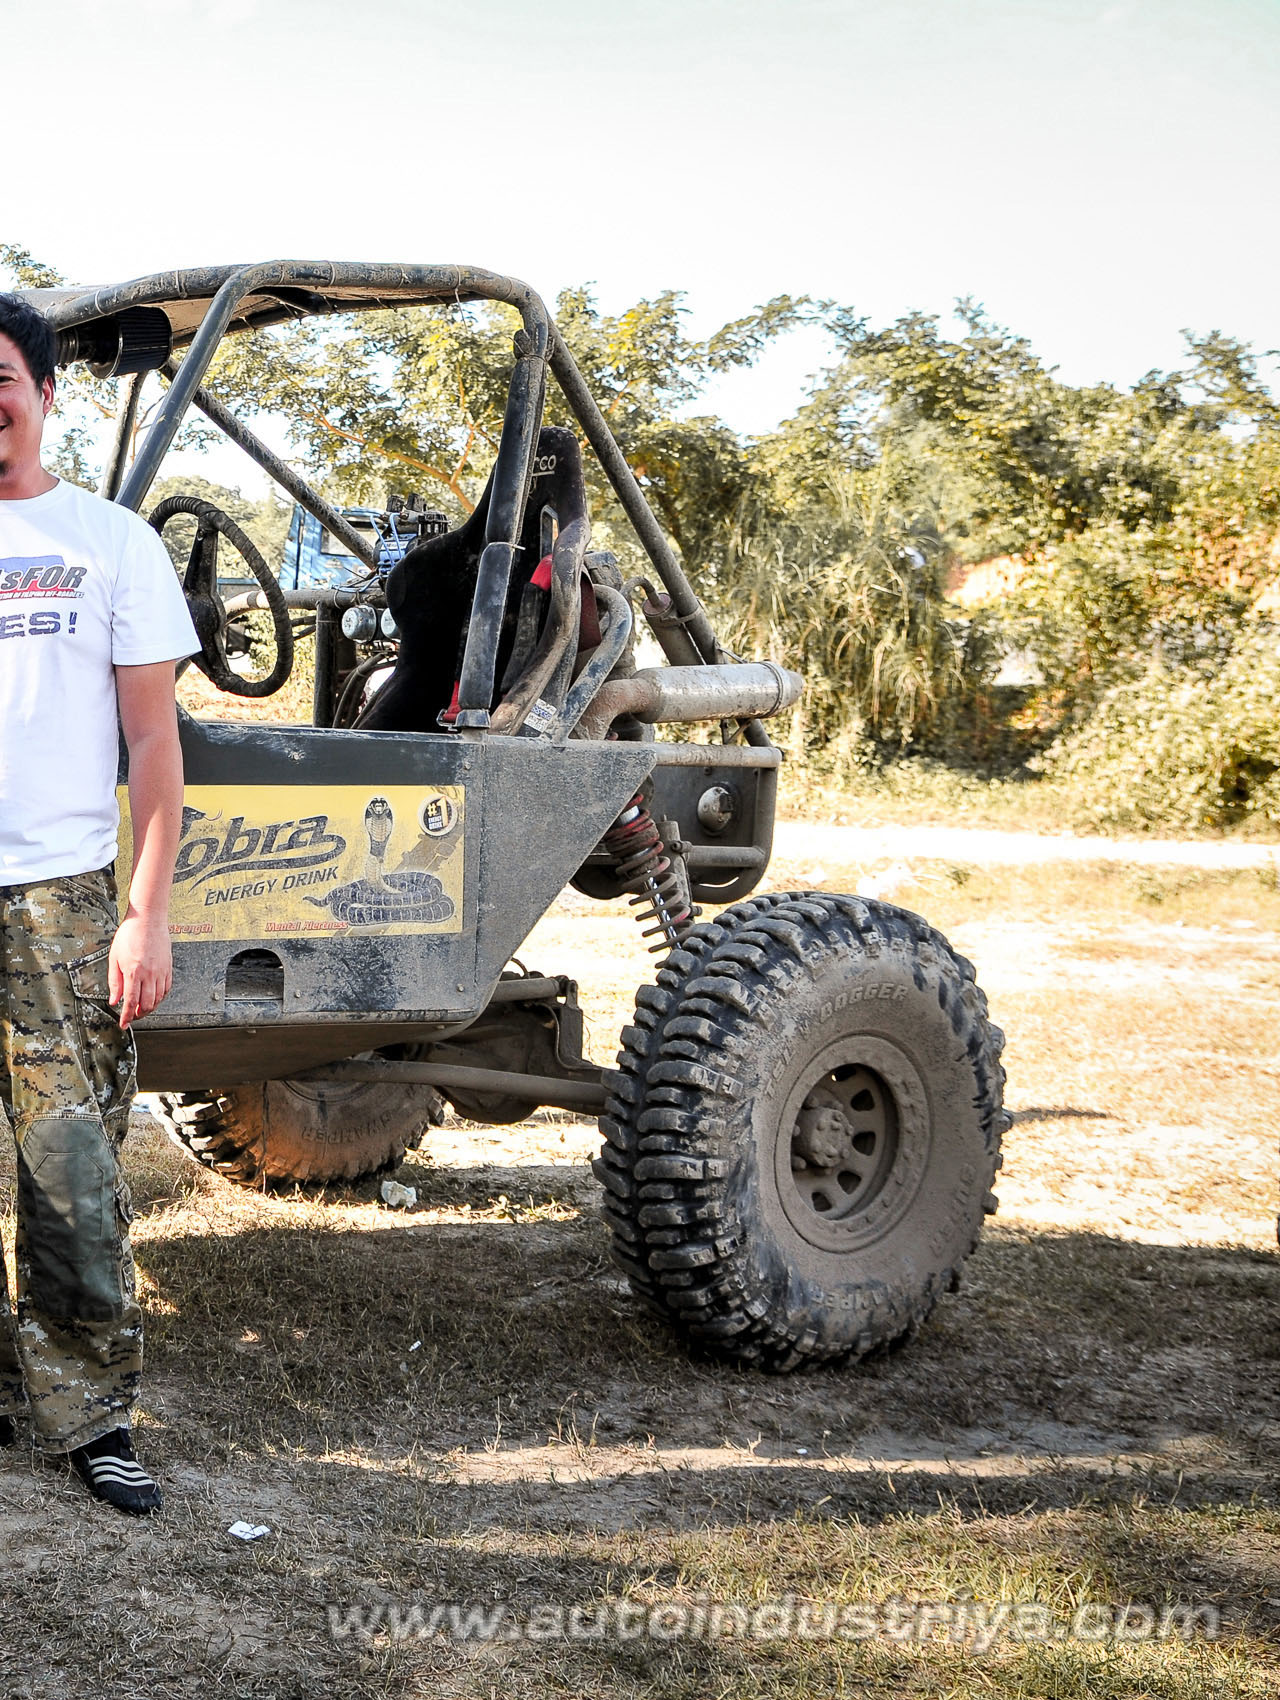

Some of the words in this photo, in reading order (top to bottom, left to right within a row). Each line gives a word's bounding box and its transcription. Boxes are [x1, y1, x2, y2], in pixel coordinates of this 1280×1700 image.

[427, 796, 448, 827] #1
[204, 878, 278, 906] ENERGY
[283, 866, 338, 890] DRINK
[265, 922, 301, 932] Mental
[302, 921, 349, 931] Alertness
[820, 981, 908, 1023] BOGGER
